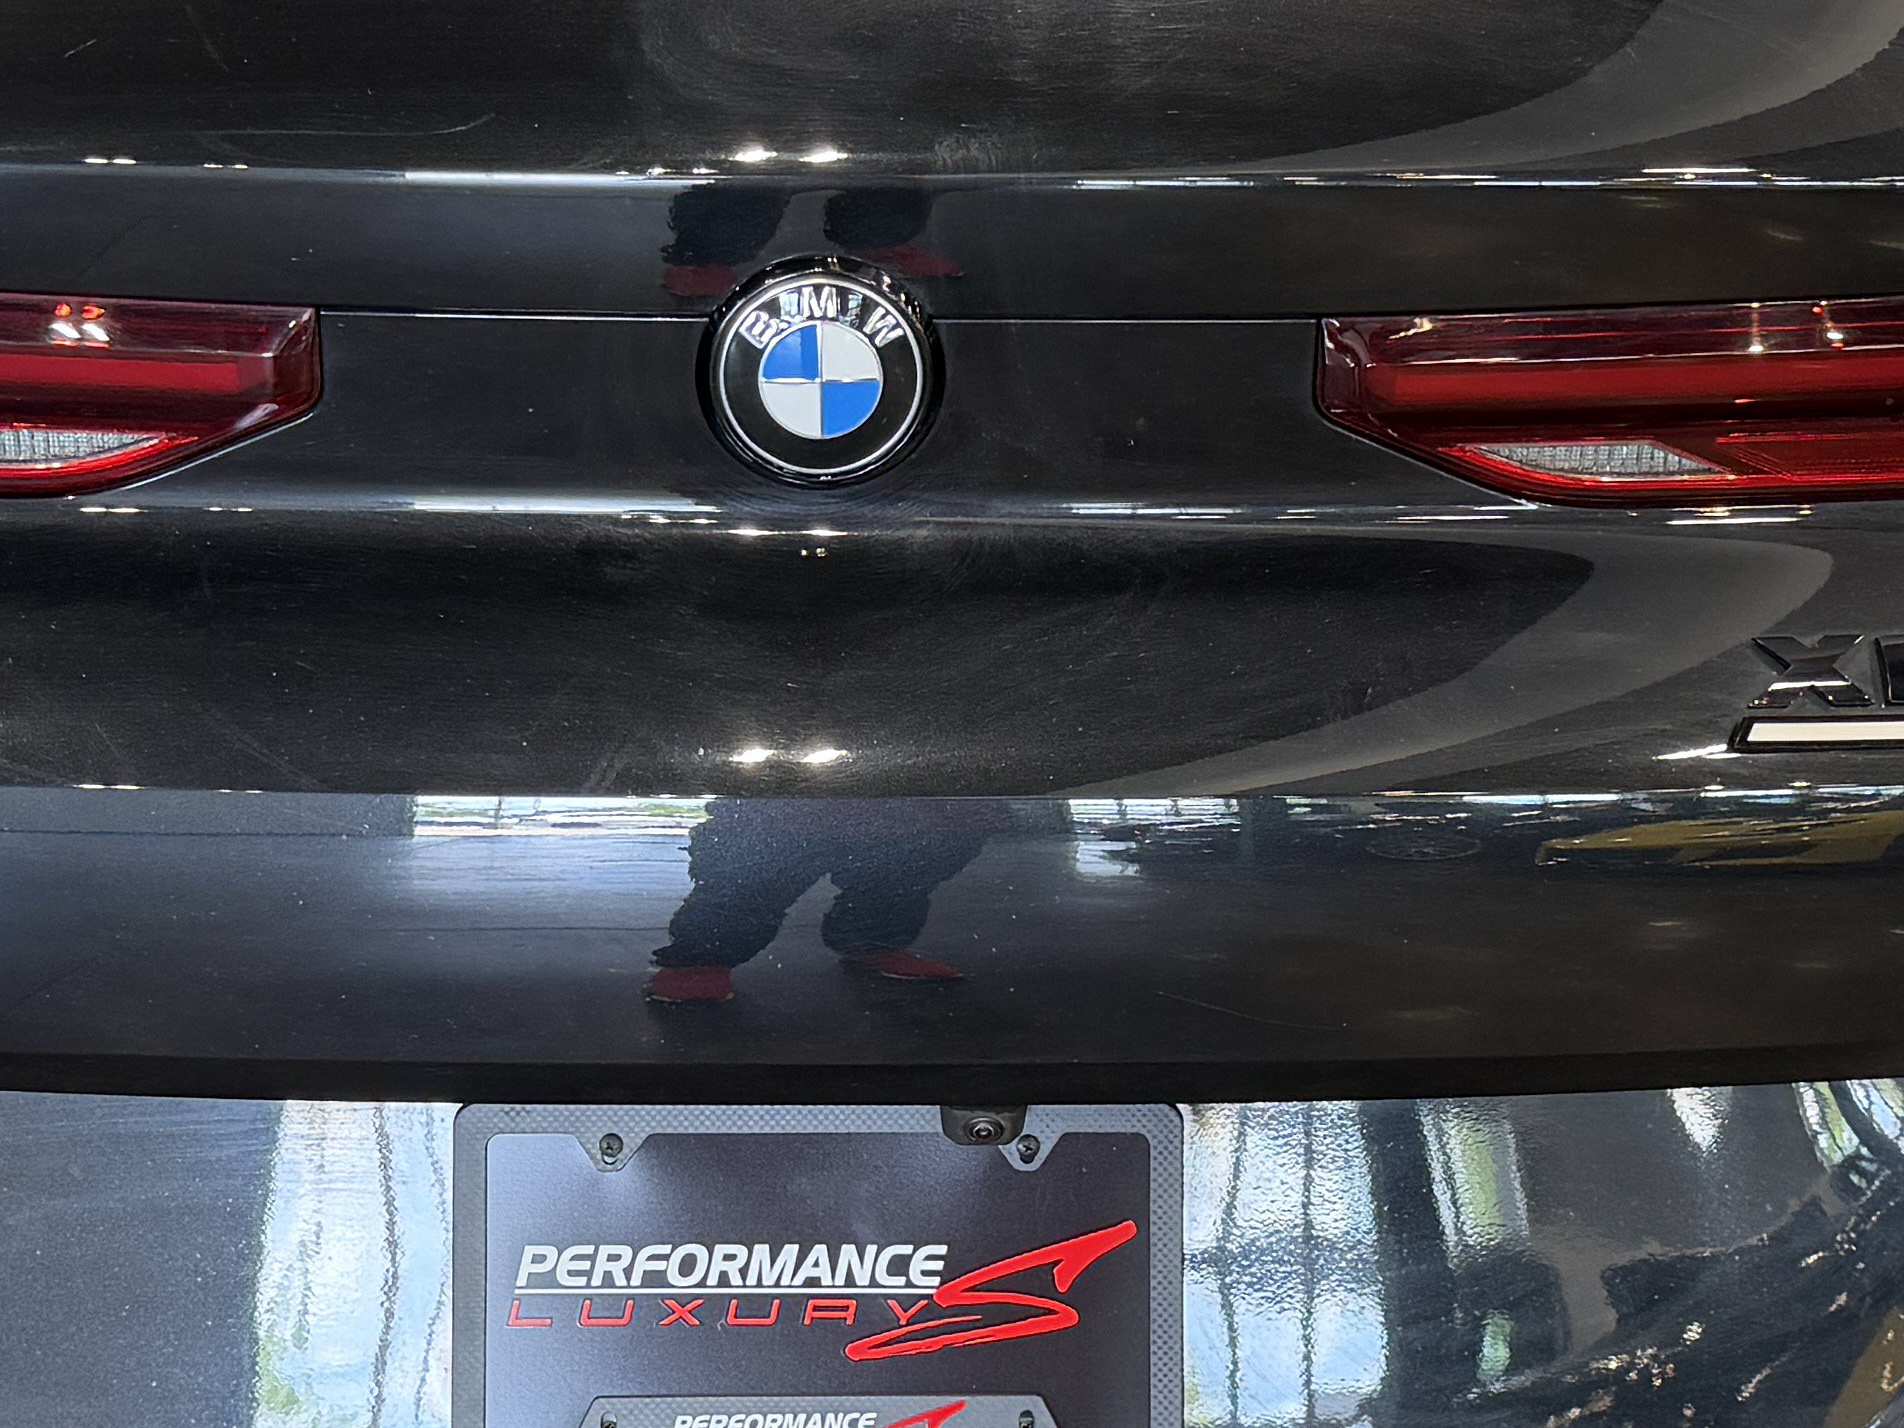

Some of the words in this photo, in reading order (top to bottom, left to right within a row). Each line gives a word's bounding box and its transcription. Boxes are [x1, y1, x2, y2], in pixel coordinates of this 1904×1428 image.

[738, 285, 905, 350] BMW
[515, 1243, 948, 1287] PERFORMANCE
[506, 1298, 929, 1327] LUXURY
